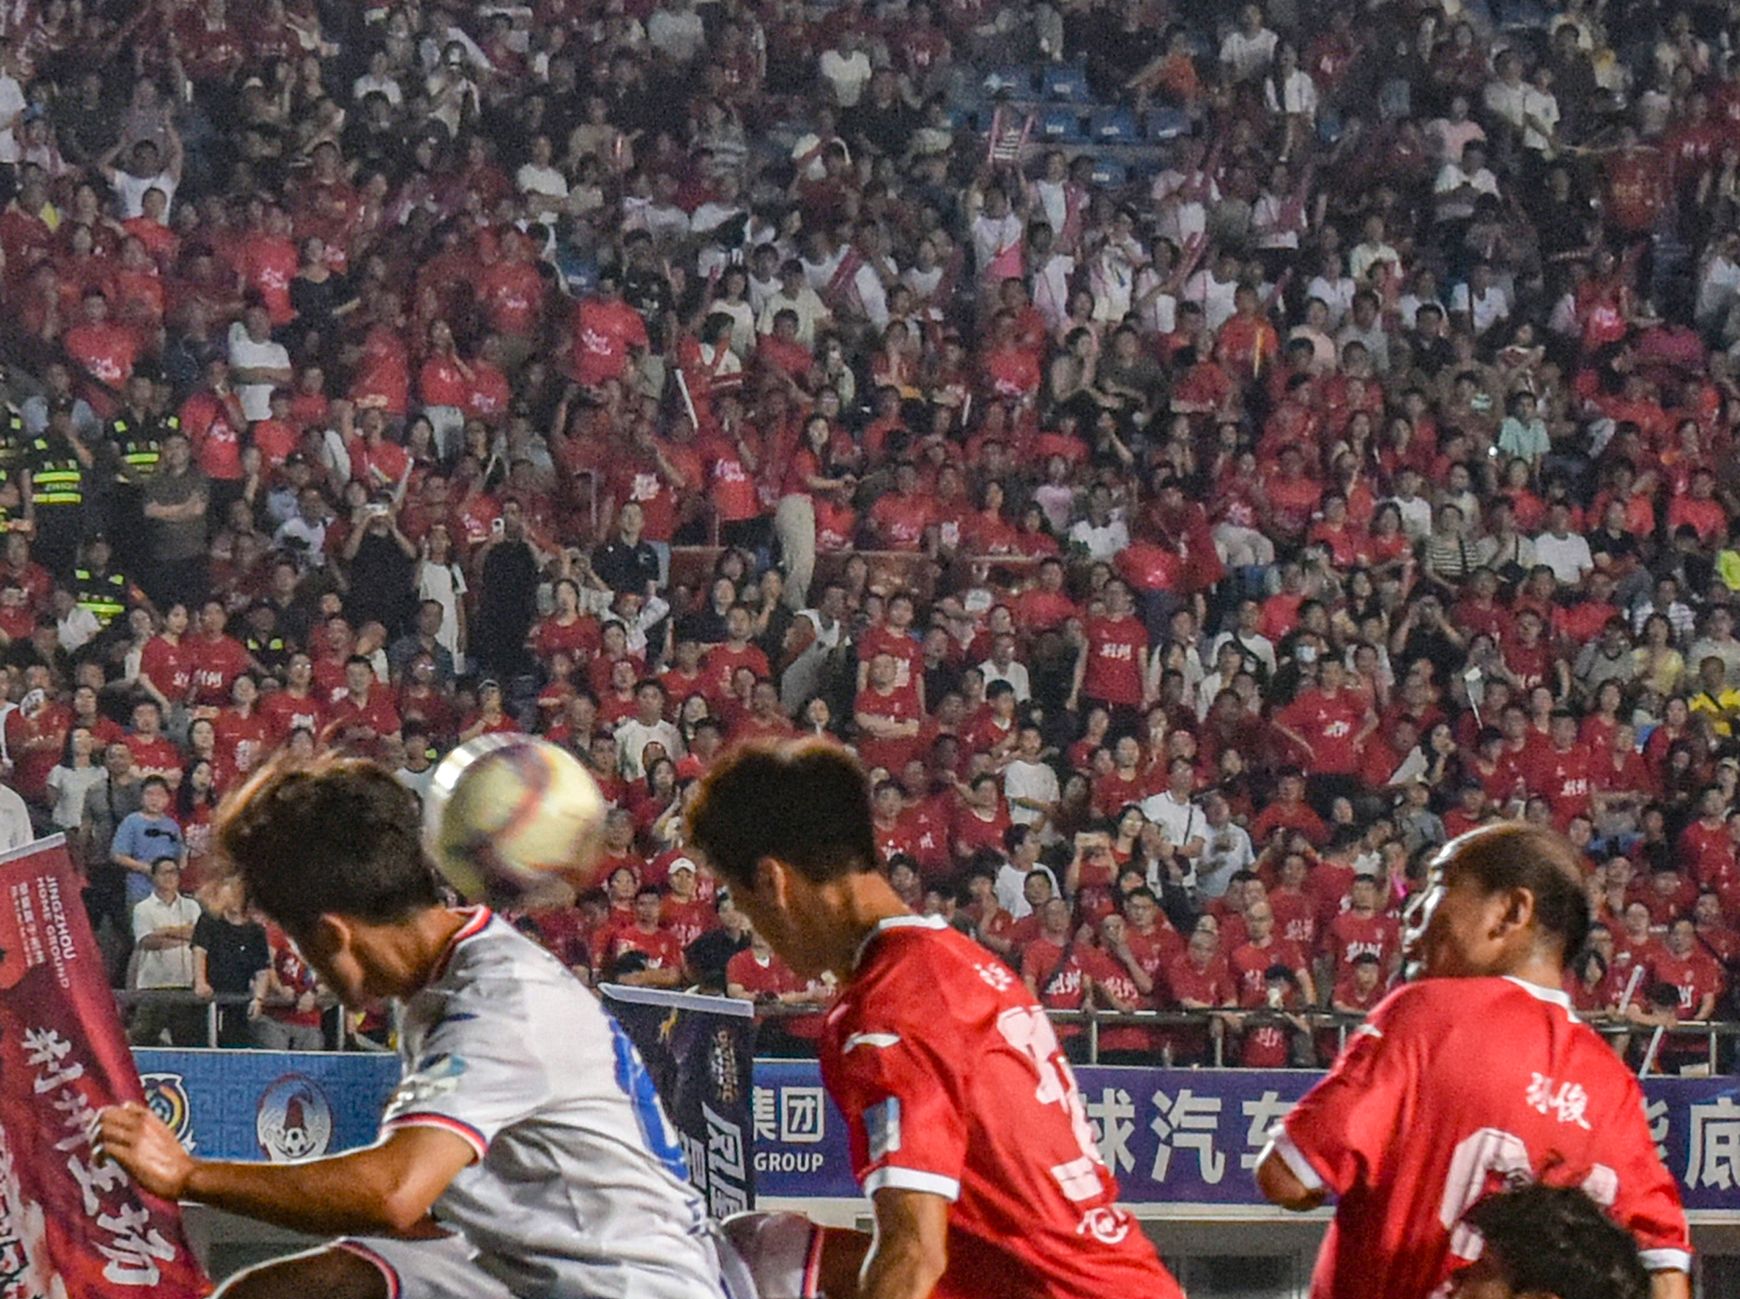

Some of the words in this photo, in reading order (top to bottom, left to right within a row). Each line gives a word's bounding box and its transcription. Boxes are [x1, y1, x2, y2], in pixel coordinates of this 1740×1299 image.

[37, 876, 53, 921] HOME
[46, 924, 70, 988] GROUND
[45, 875, 77, 959] JINGZHOU
[753, 1152, 824, 1172] GROUP
